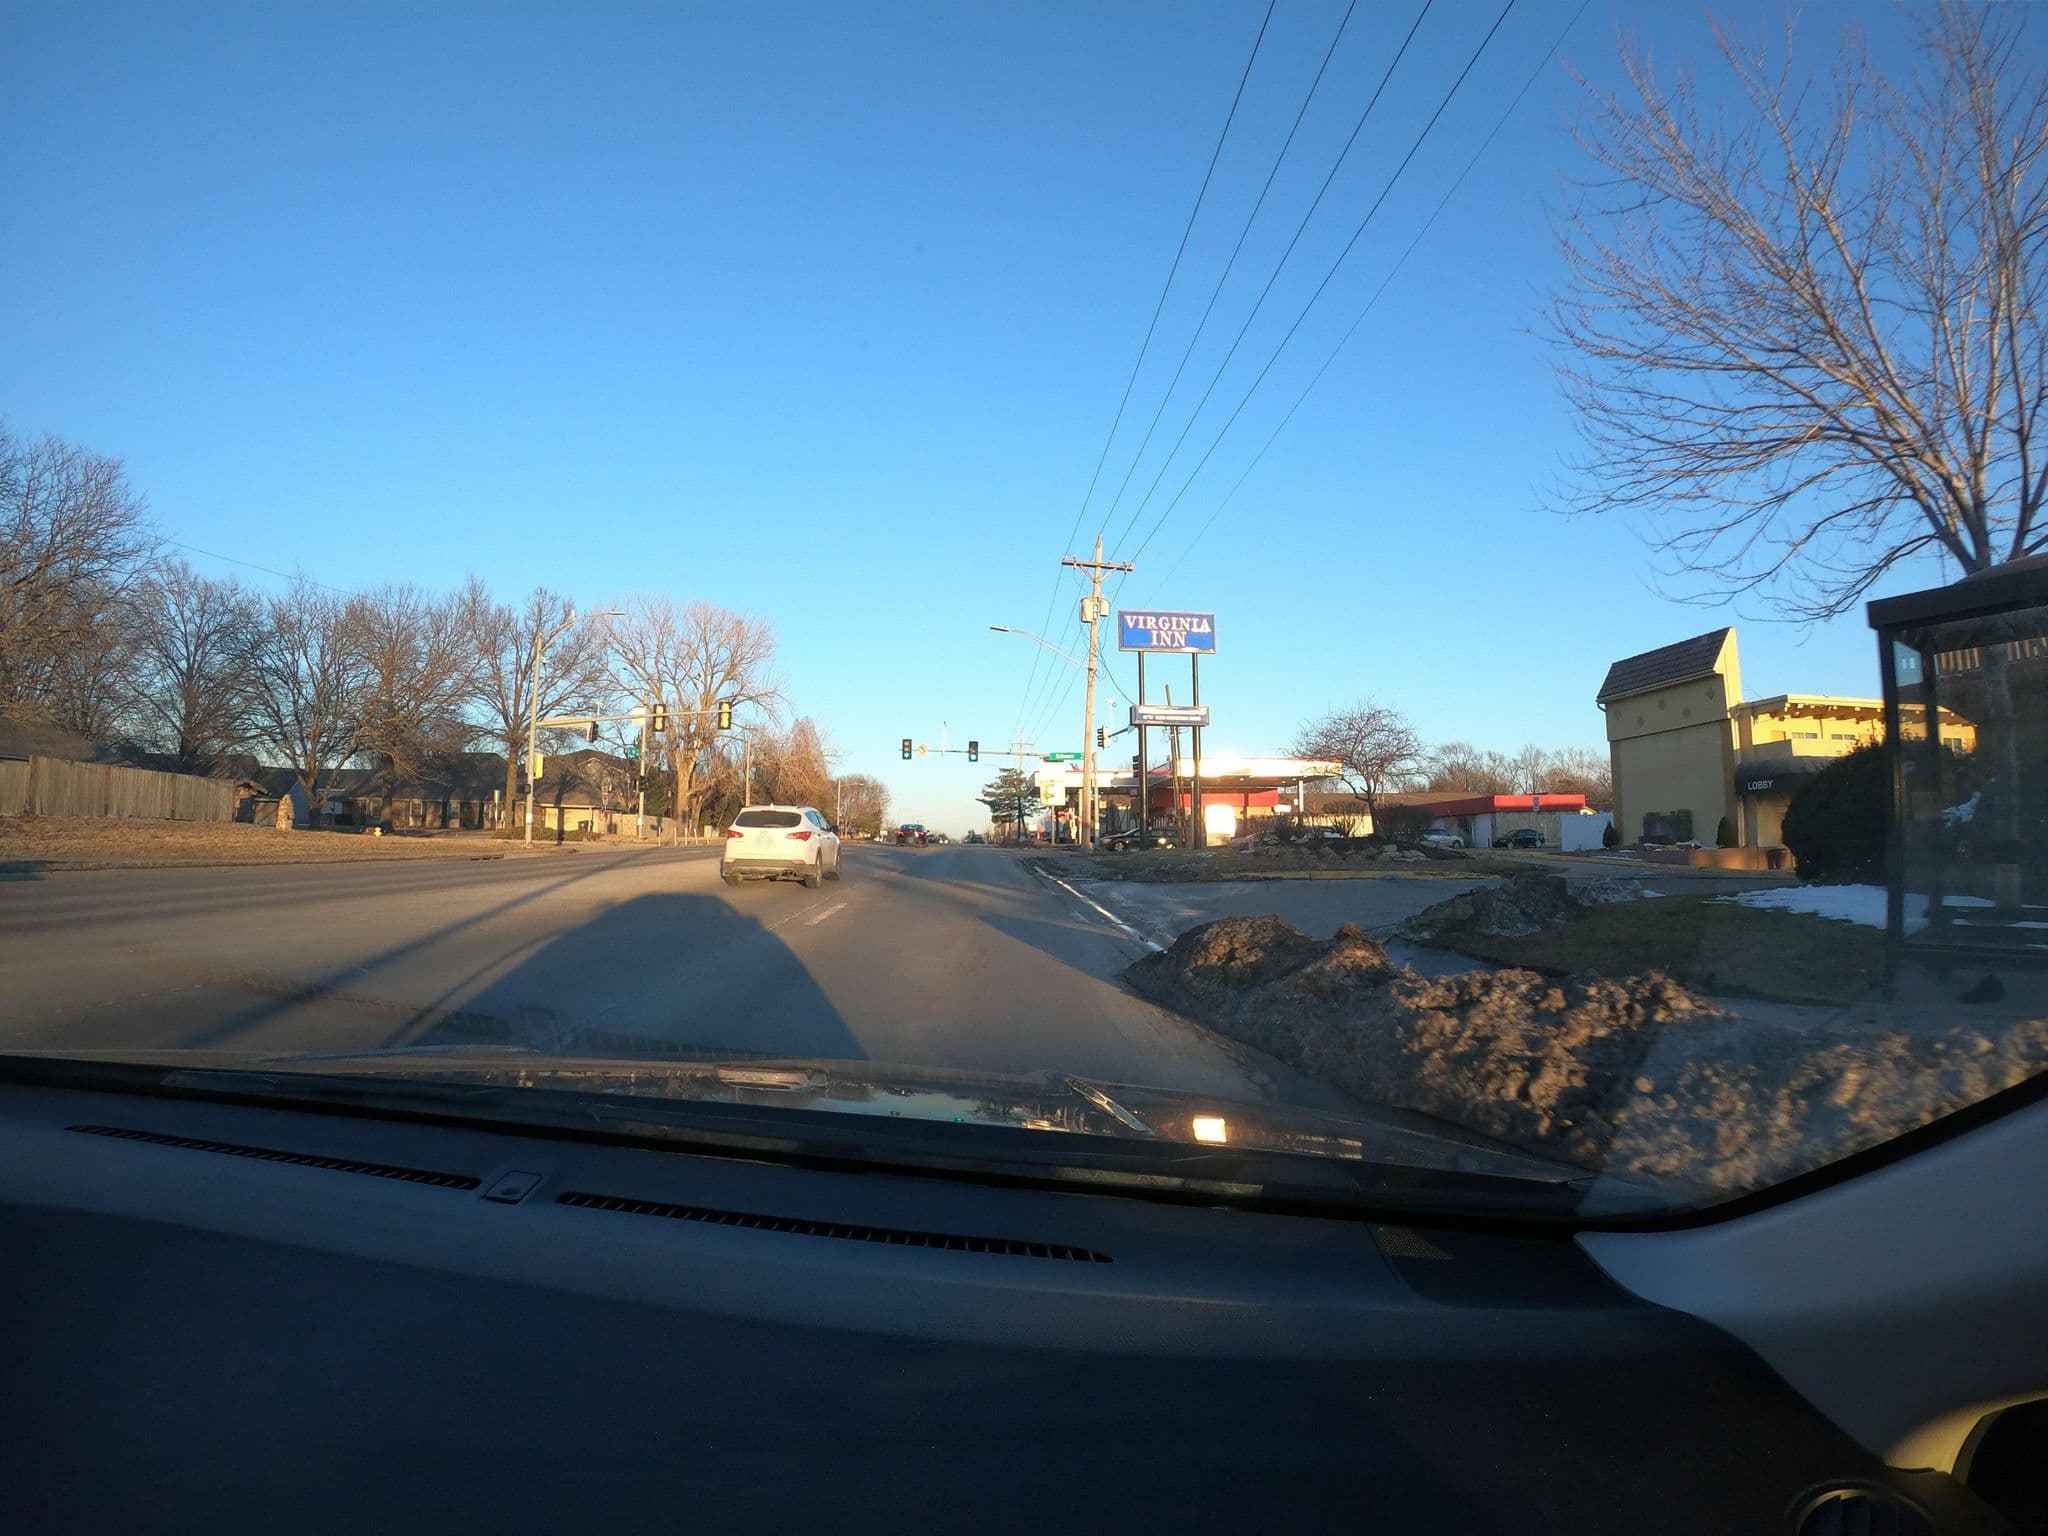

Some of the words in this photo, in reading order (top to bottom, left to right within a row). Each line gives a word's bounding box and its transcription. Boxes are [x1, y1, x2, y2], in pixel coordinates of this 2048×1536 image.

[1125, 616, 1211, 633] VIRGINIA
[1151, 630, 1186, 647] INN
[1747, 780, 1773, 790] LOBBY
